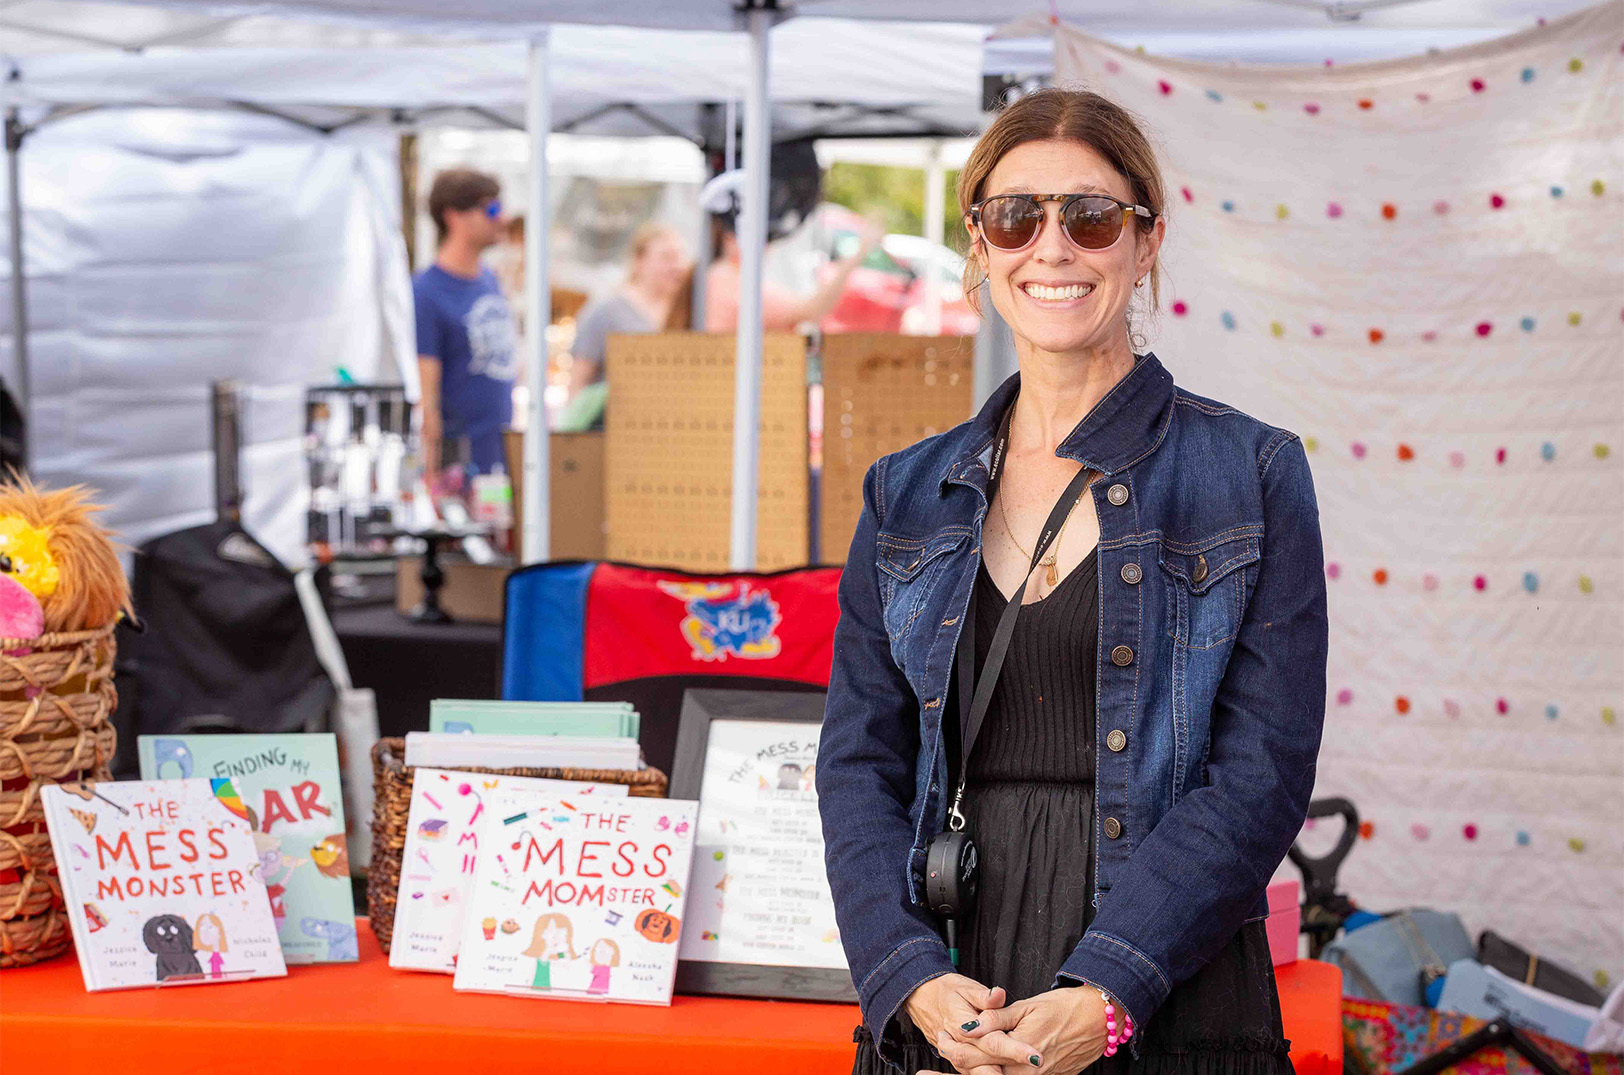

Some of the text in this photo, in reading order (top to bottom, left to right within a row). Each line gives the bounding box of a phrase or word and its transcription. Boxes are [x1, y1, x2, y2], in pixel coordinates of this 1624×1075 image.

[717, 609, 749, 634] KU
[213, 747, 310, 777] FINDING MY
[756, 741, 799, 761] MESS
[133, 801, 180, 819] THE
[581, 813, 632, 833] THE
[95, 828, 229, 872] MESS
[522, 837, 673, 878] MESS
[97, 870, 247, 901] MONSTER
[521, 879, 656, 907] MOMSTER
